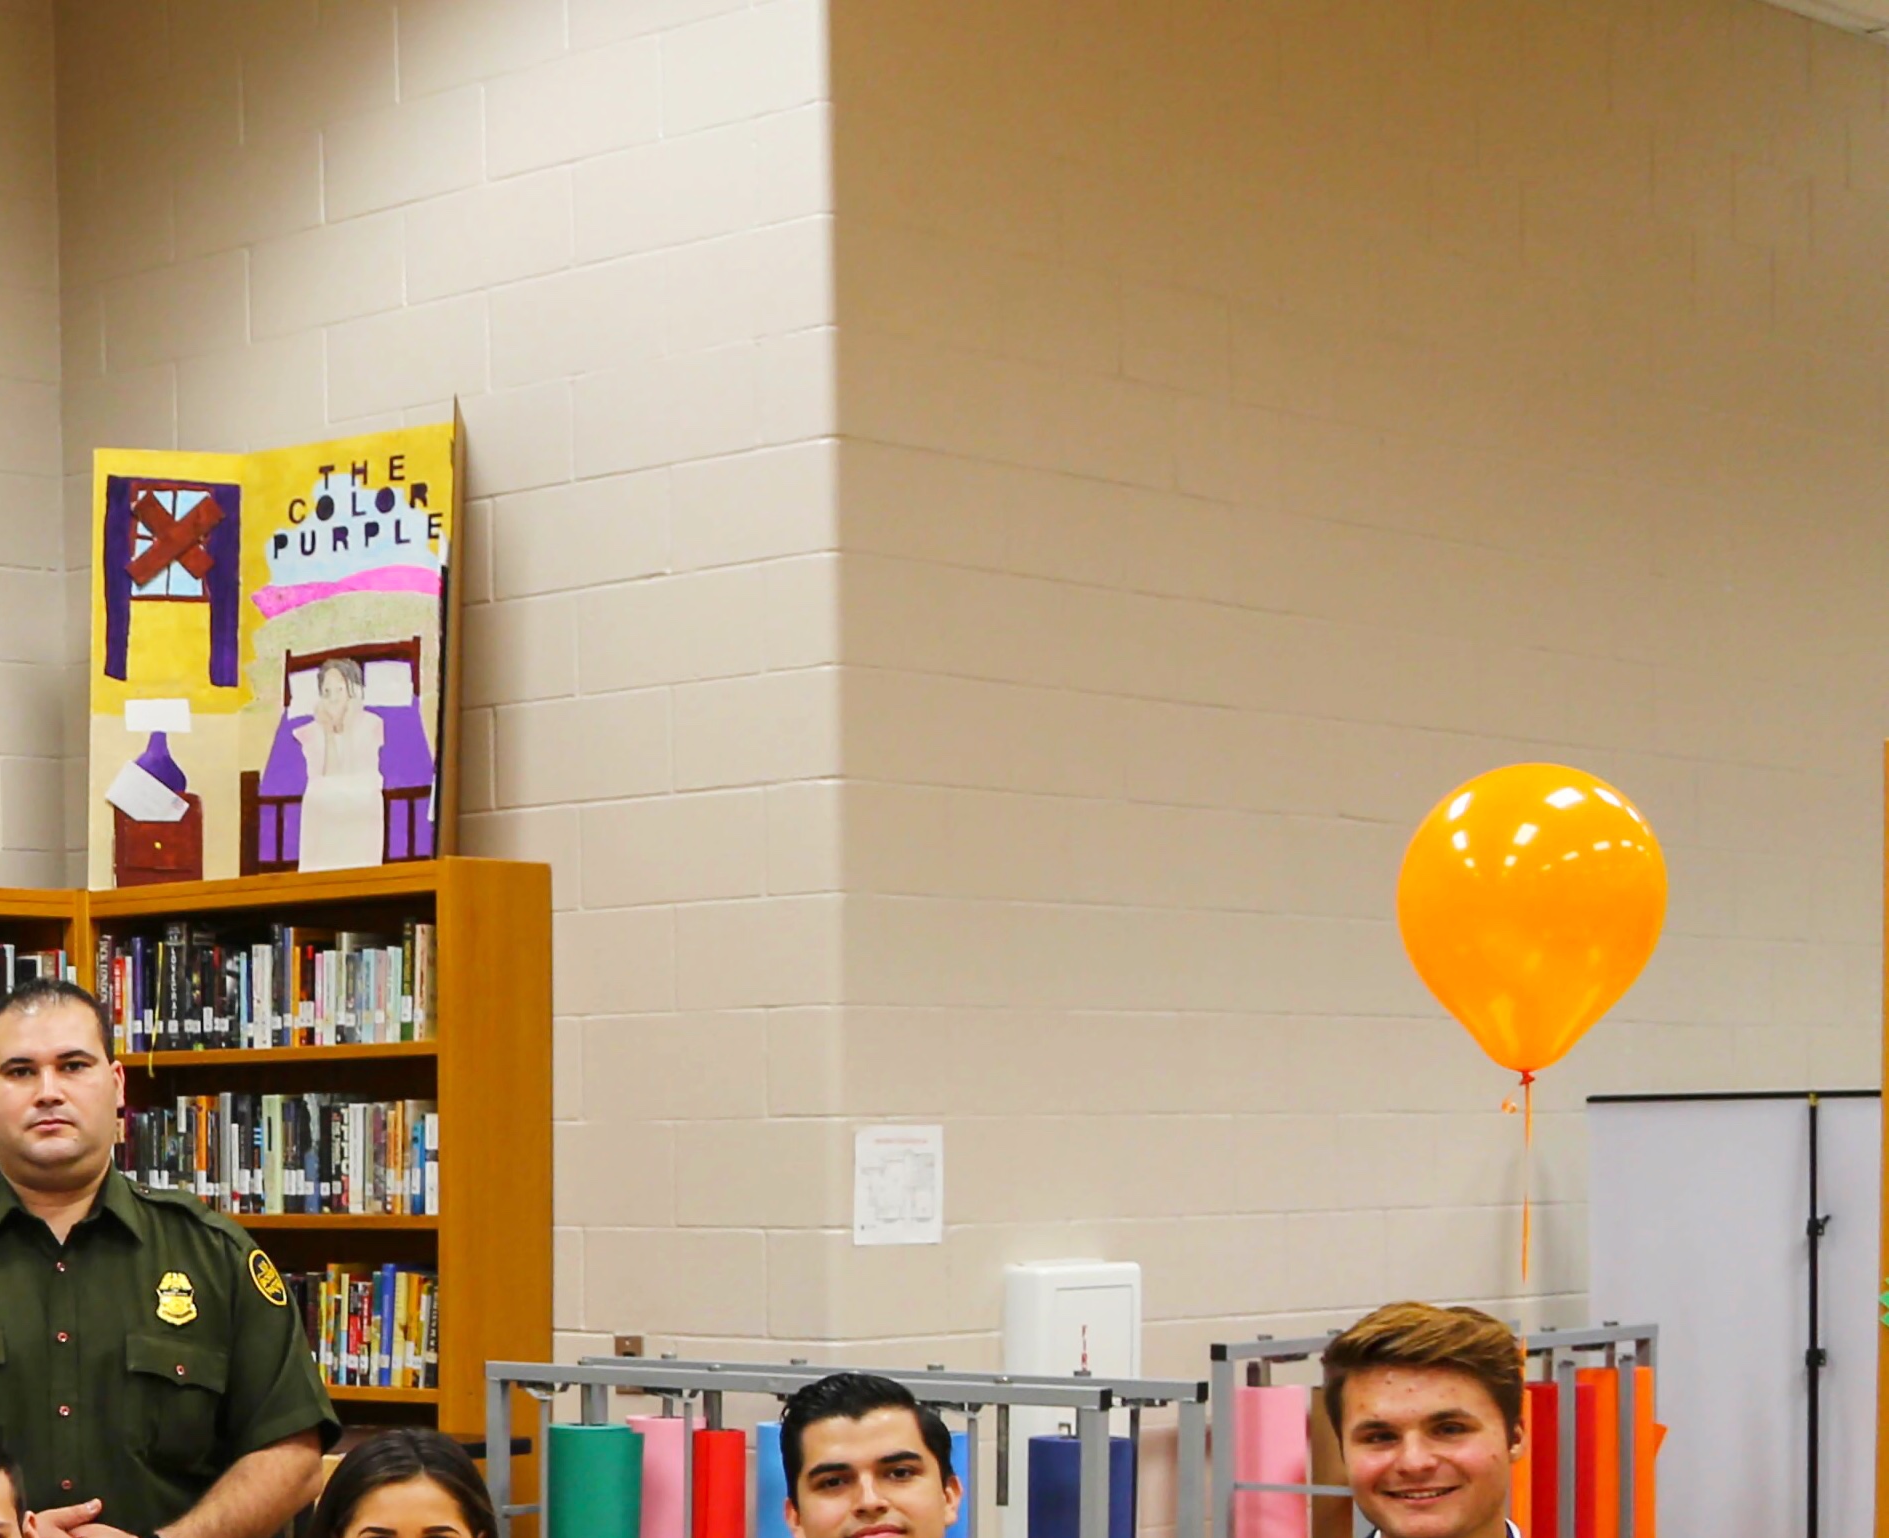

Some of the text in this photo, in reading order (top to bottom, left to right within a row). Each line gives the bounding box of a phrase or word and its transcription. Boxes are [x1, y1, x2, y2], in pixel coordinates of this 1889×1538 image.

[319, 455, 405, 490] THE
[289, 483, 430, 524] COLOR
[273, 513, 443, 559] PURPLE
[99, 964, 109, 1003] LONDON
